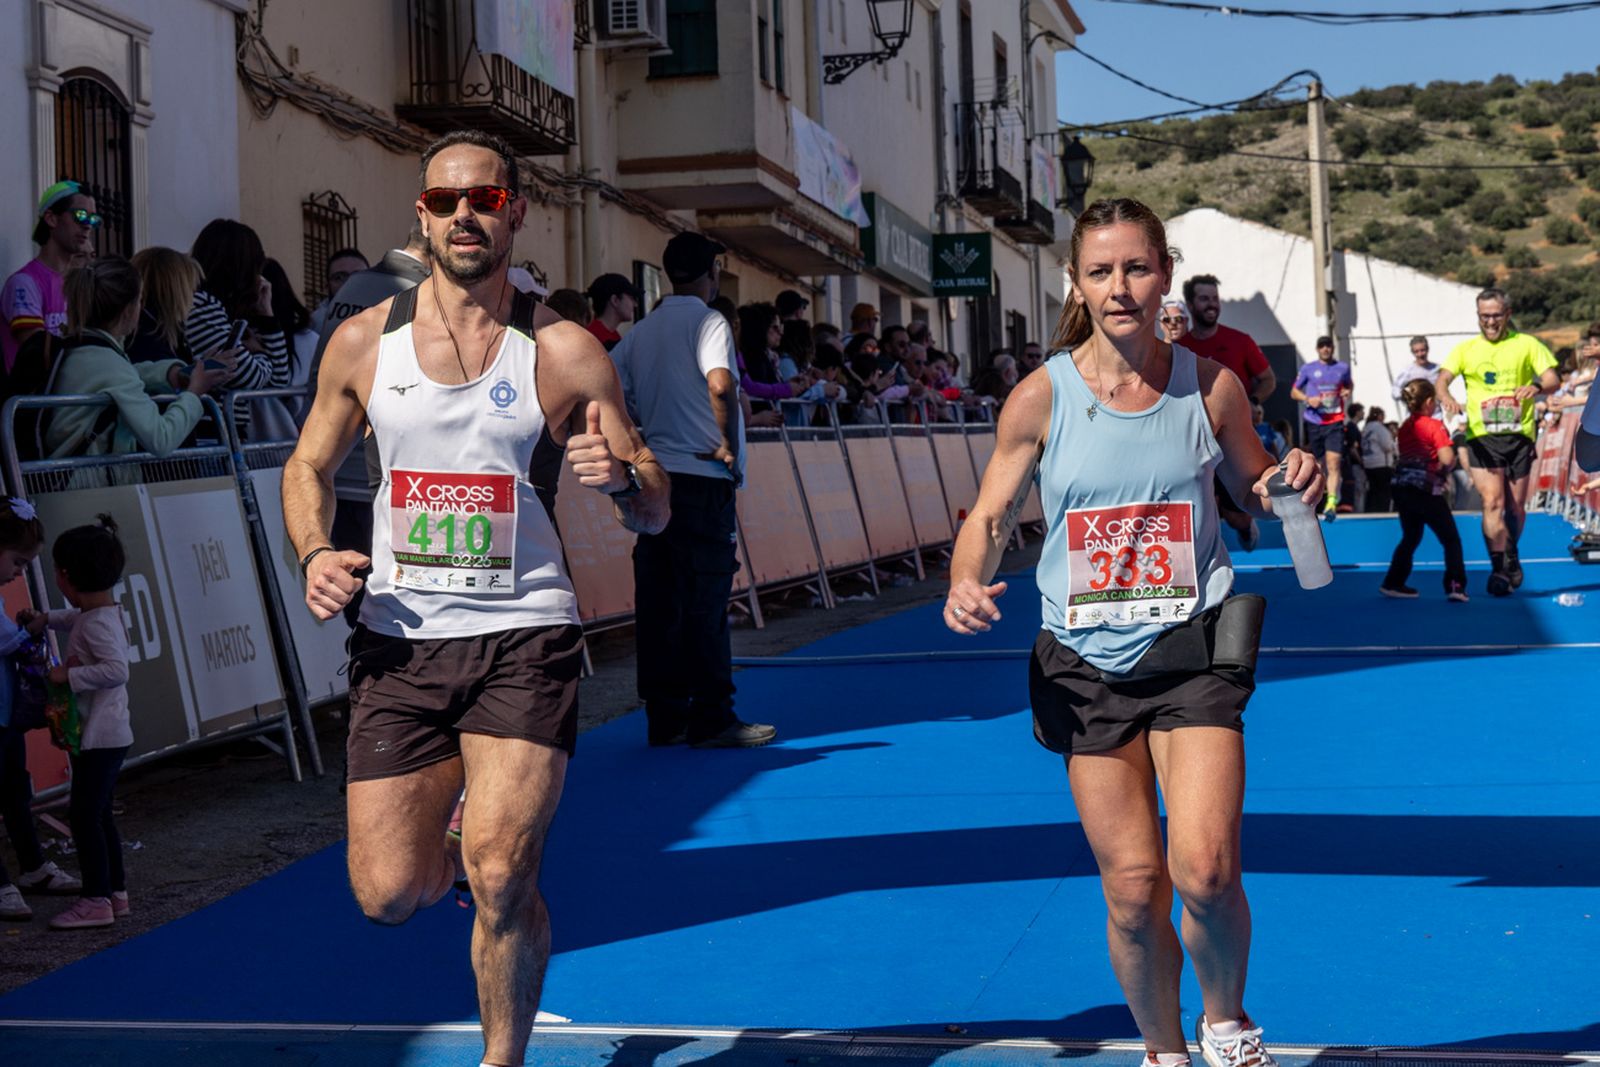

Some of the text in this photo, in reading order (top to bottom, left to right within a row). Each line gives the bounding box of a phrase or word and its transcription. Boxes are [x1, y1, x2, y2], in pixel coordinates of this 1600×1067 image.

[957, 277, 988, 287] RURAL
[406, 475, 424, 500] X
[427, 485, 495, 502] CROSS
[405, 500, 479, 516] PANTANO
[408, 512, 492, 556] 410
[1083, 515, 1103, 538] X
[1106, 516, 1170, 537] CROSS
[1084, 533, 1155, 553] PANTANO
[192, 537, 231, 597] JAÉN
[1089, 544, 1173, 591] 333
[1074, 591, 1109, 604] MONICA
[112, 573, 161, 663] ED
[201, 624, 257, 672] MARTOS
